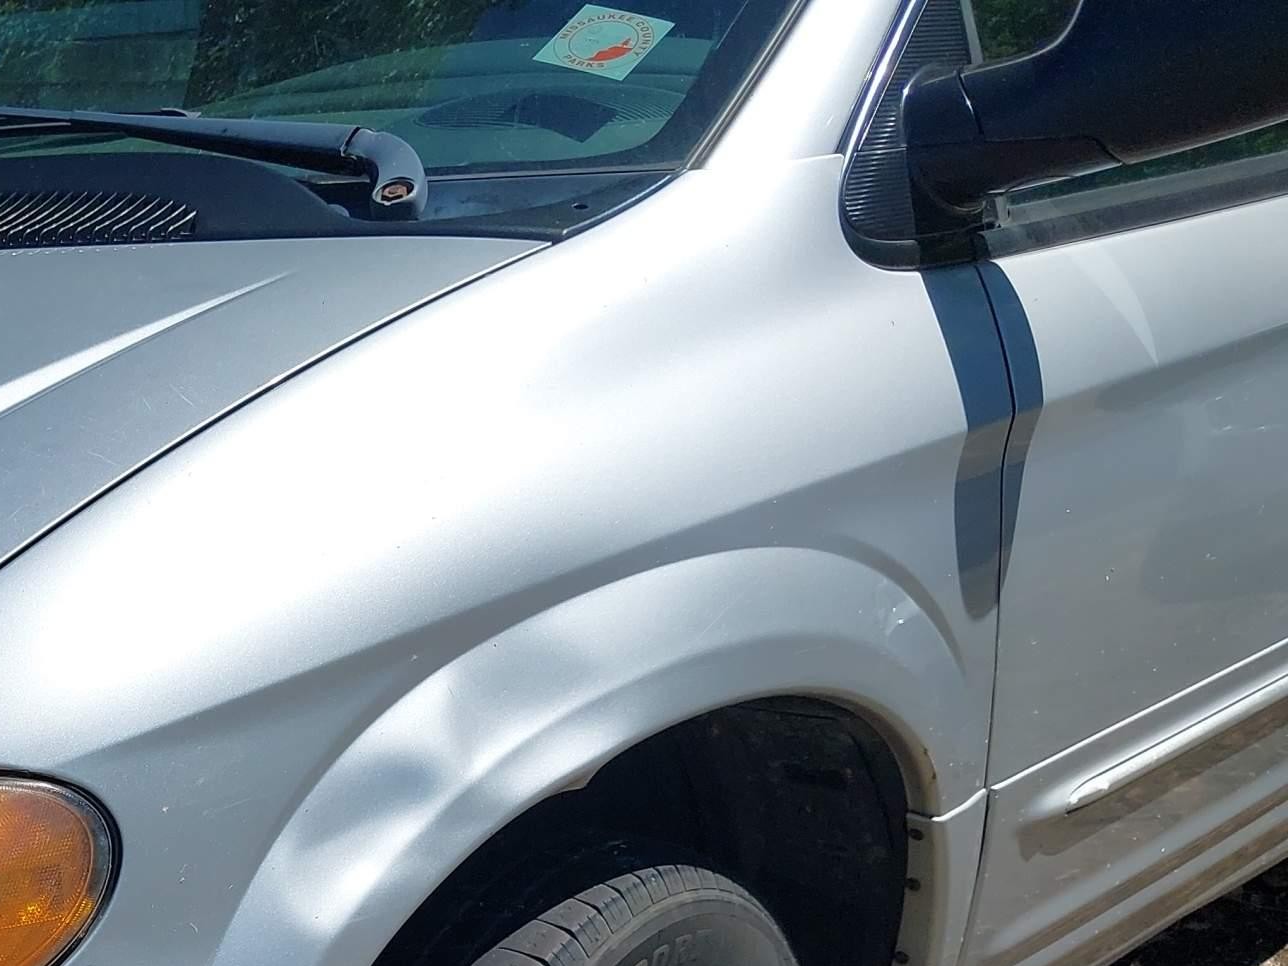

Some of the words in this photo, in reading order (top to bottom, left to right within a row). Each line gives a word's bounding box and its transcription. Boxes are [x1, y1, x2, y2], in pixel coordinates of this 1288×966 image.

[560, 14, 635, 40] MISSAUKEE
[634, 20, 652, 57] COUNTY
[563, 54, 605, 68] PARKS
